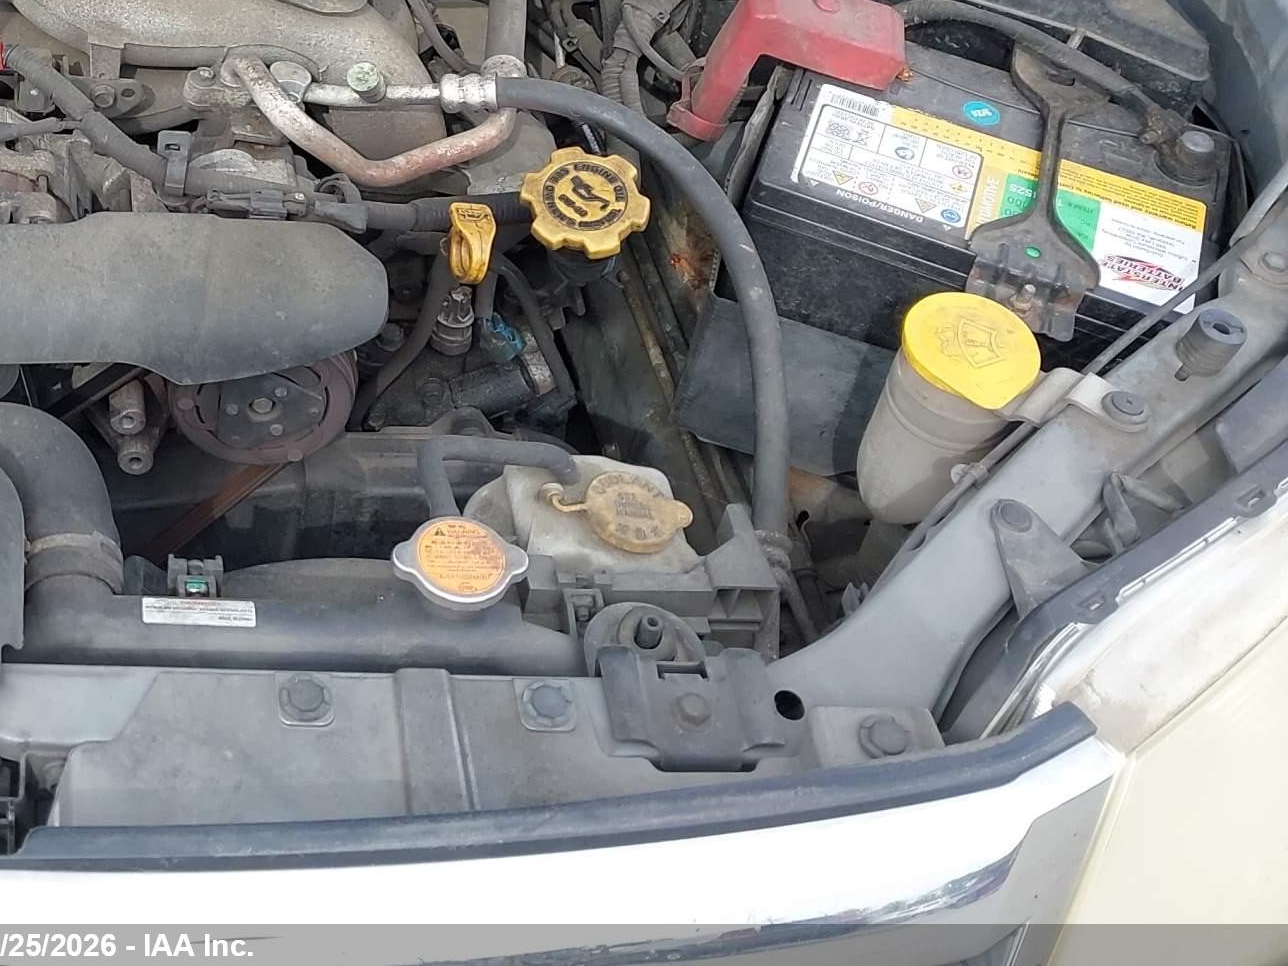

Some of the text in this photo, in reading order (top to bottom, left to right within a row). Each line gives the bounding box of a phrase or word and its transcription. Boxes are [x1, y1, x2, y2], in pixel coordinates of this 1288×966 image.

[613, 184, 626, 202] OIL
[836, 188, 924, 223] DANGER/POISON
[1106, 254, 1184, 285] BATTERIES
